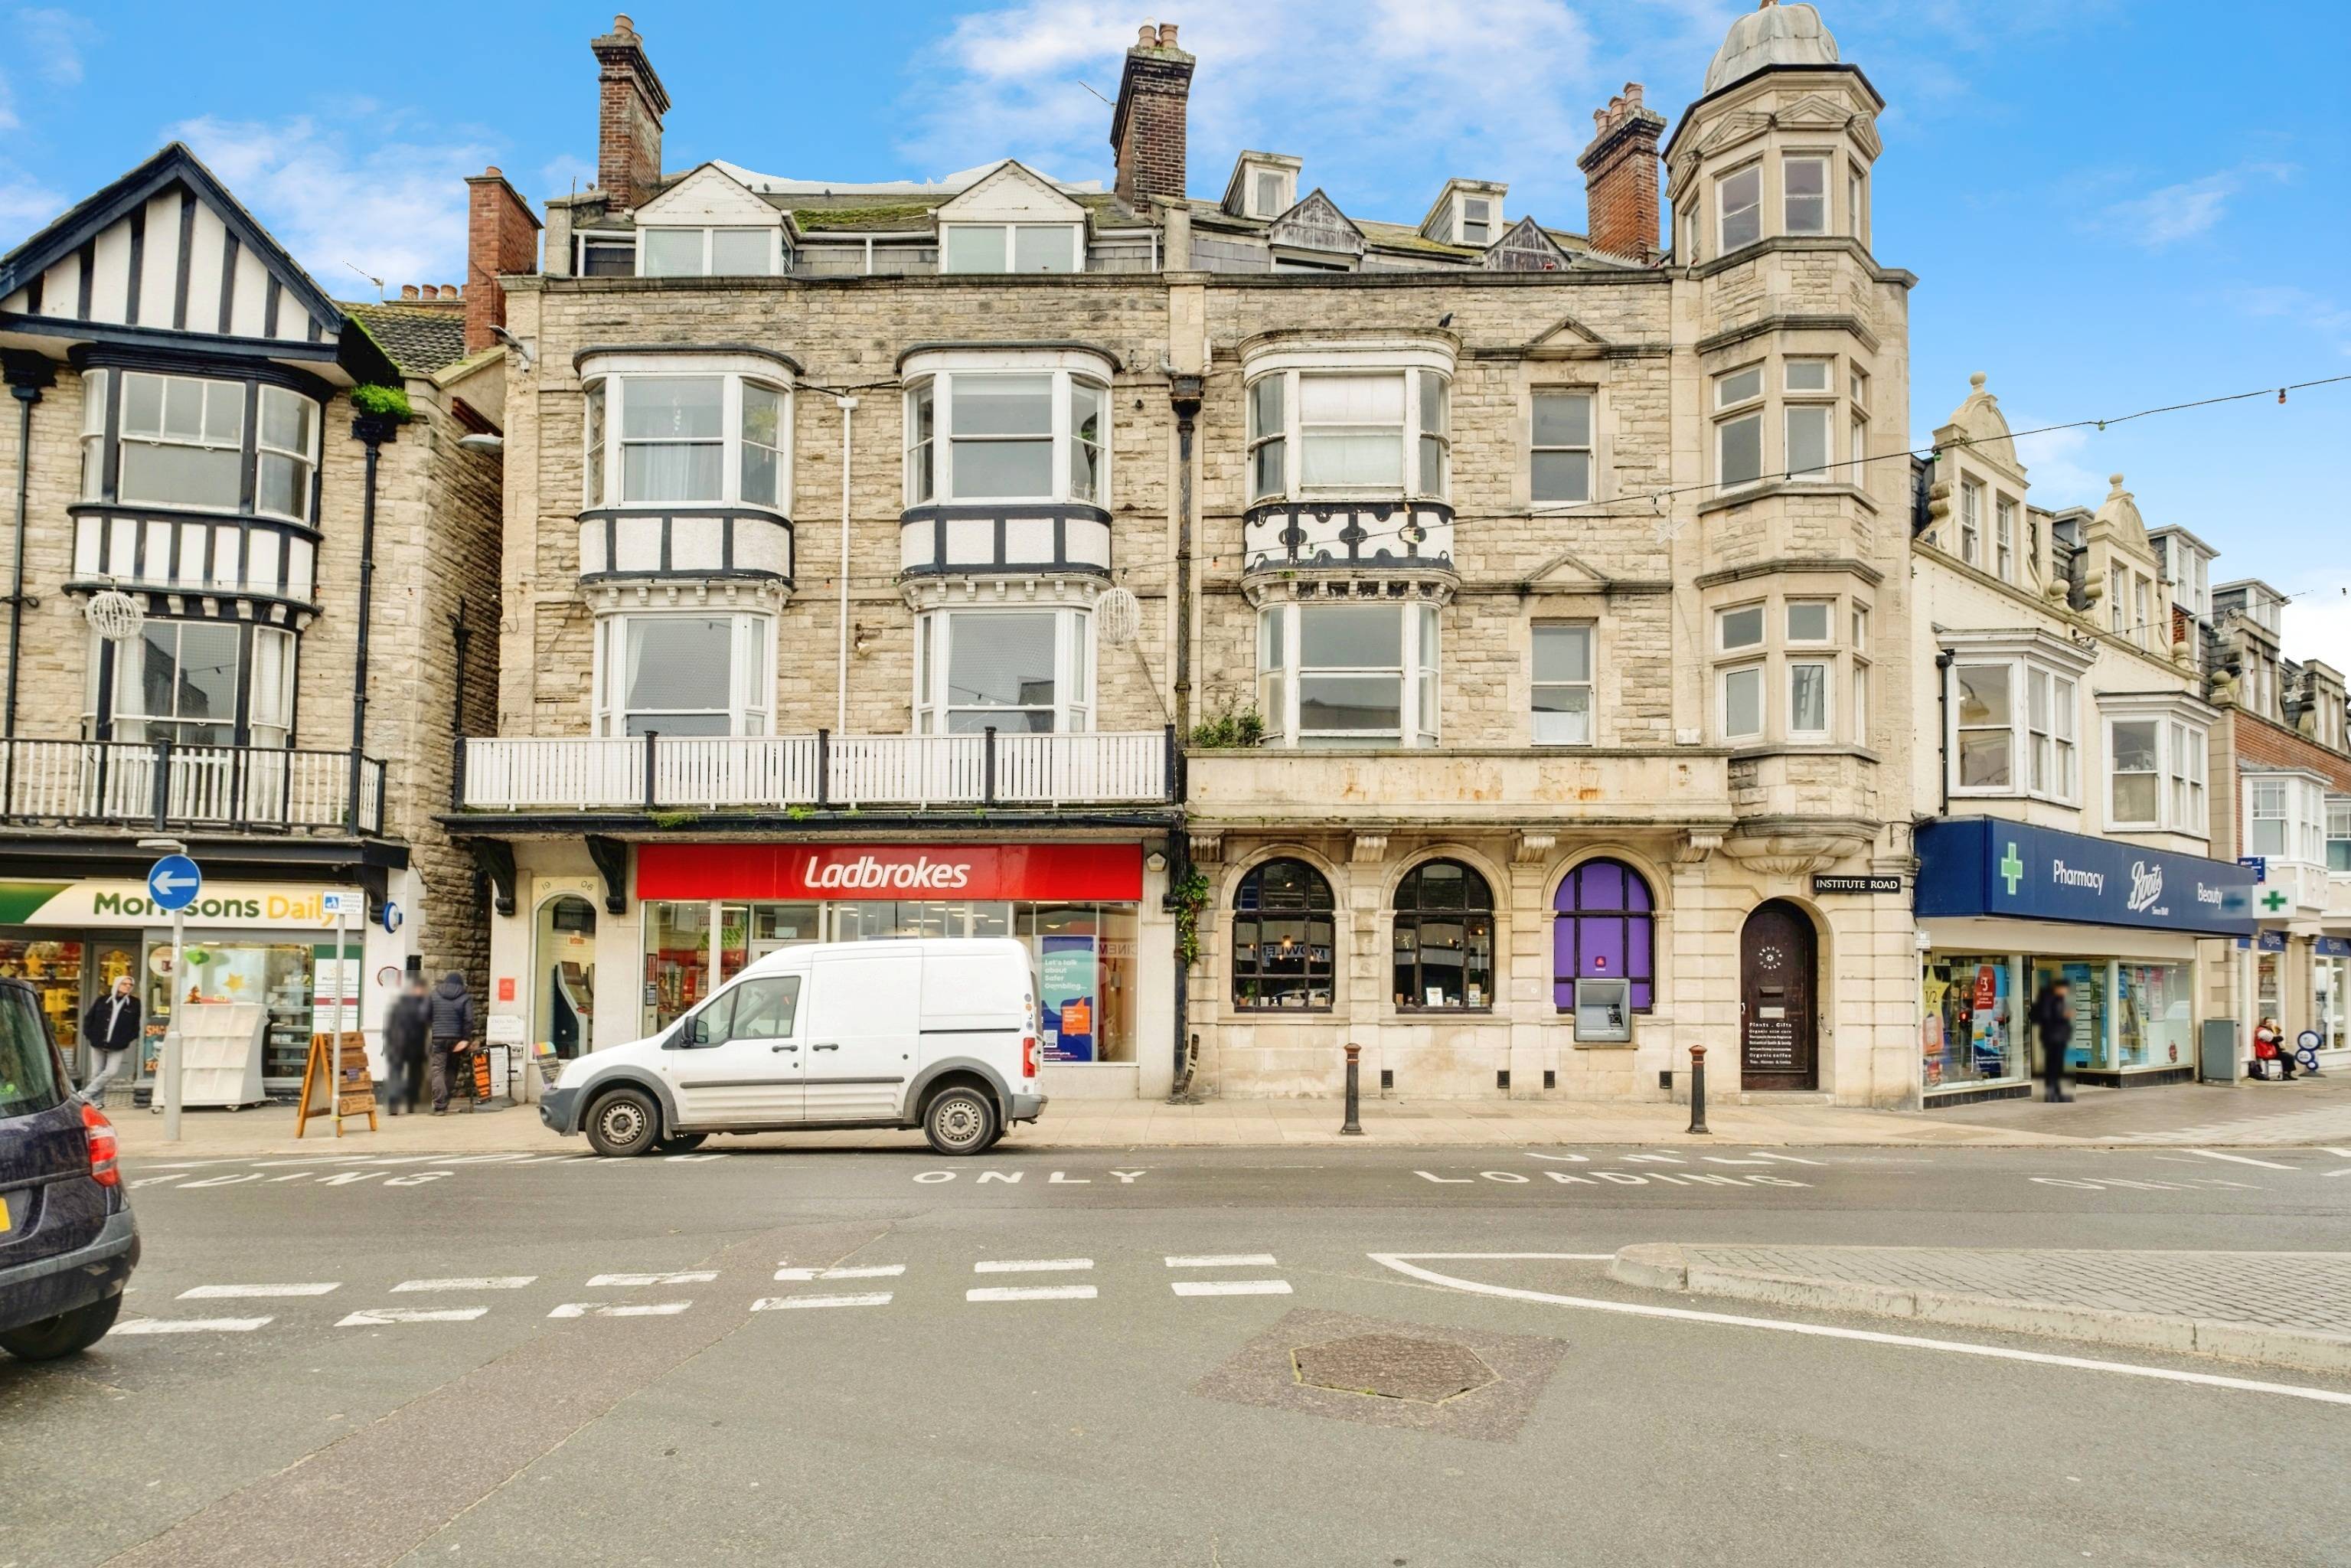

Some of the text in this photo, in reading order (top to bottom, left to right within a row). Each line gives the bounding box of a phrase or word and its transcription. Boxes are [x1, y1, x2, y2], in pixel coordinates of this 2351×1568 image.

[804, 856, 971, 888] Ladbrokes
[1816, 879, 1898, 889] INSTITUTE ROAD
[2053, 859, 2104, 896] Pharmacy
[2127, 861, 2163, 913] Boots
[2197, 882, 2223, 910] Beauty
[93, 892, 260, 918] Morsons
[913, 1171, 1146, 1184] ONLY
[1413, 1170, 1814, 1188] LOADING
